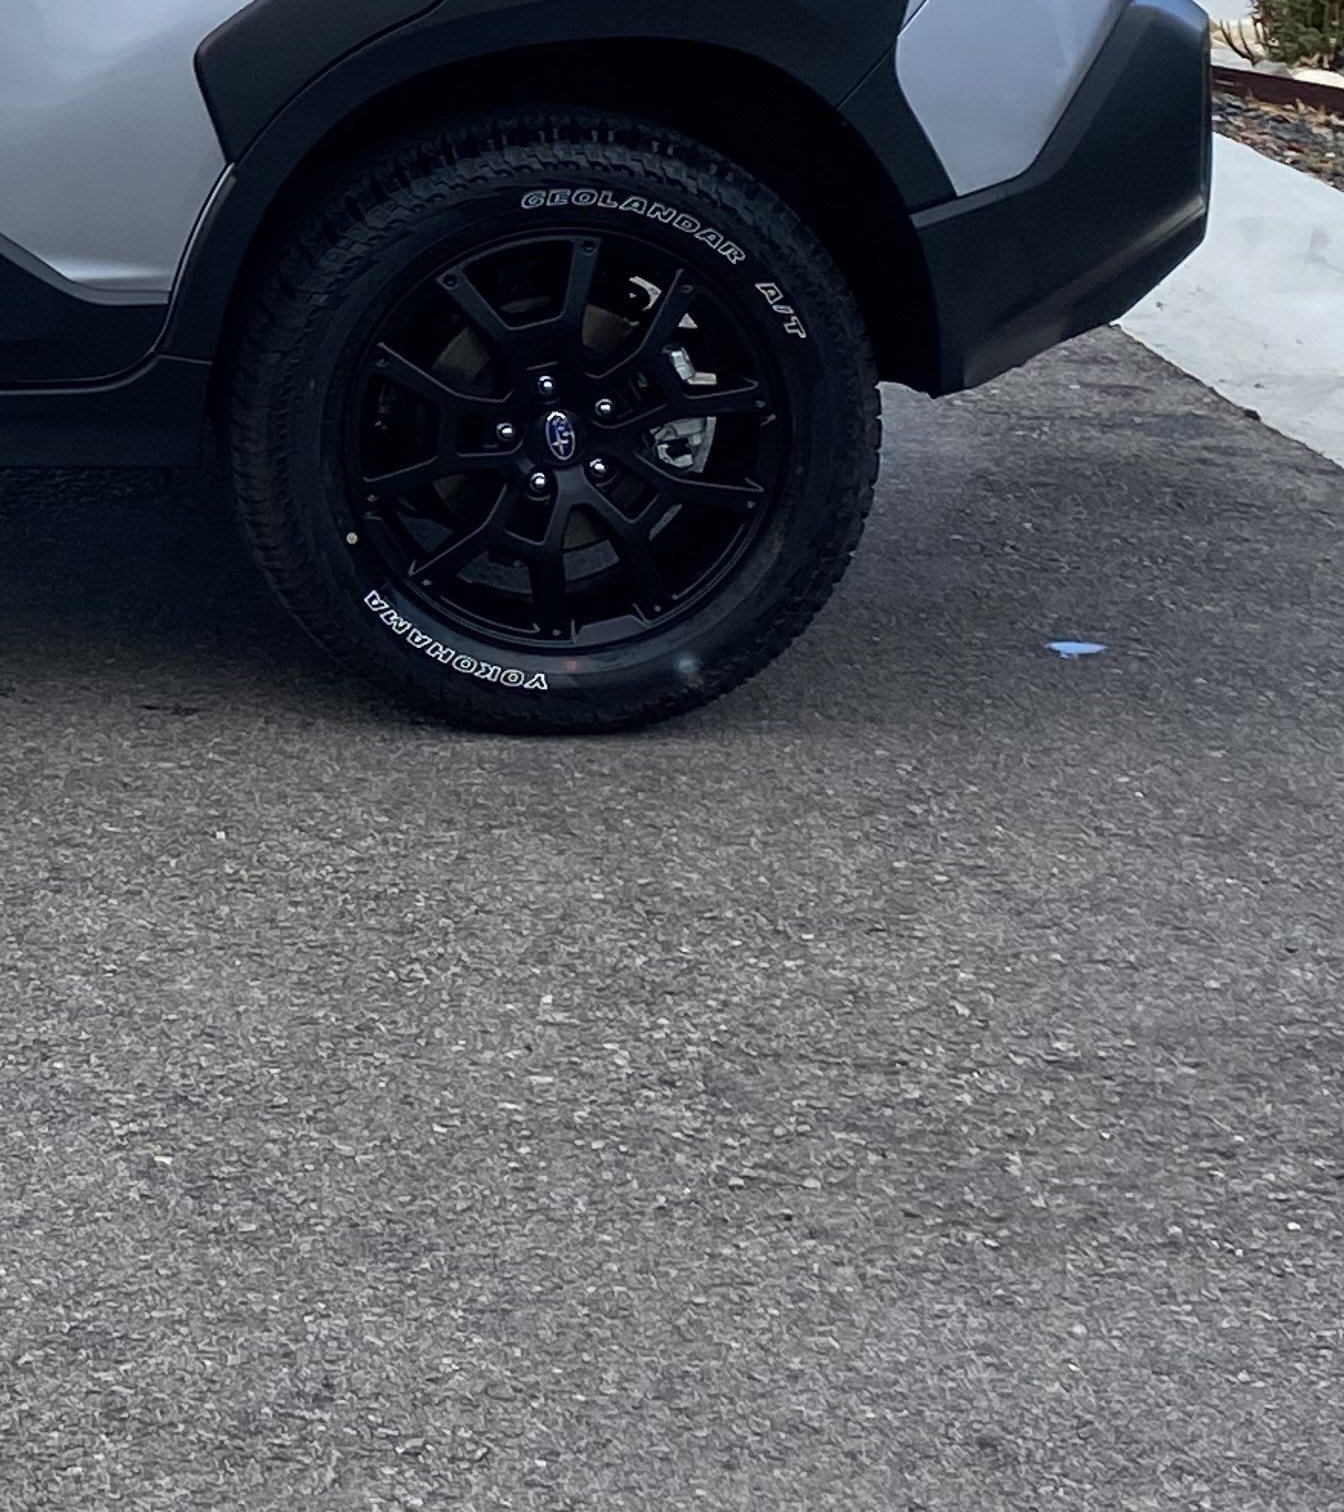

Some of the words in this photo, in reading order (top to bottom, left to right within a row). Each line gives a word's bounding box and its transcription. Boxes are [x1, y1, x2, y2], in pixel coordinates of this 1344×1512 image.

[521, 188, 745, 265] GEOLANDAR
[754, 282, 807, 339] A/T
[364, 590, 548, 690] YOKOHAMA
